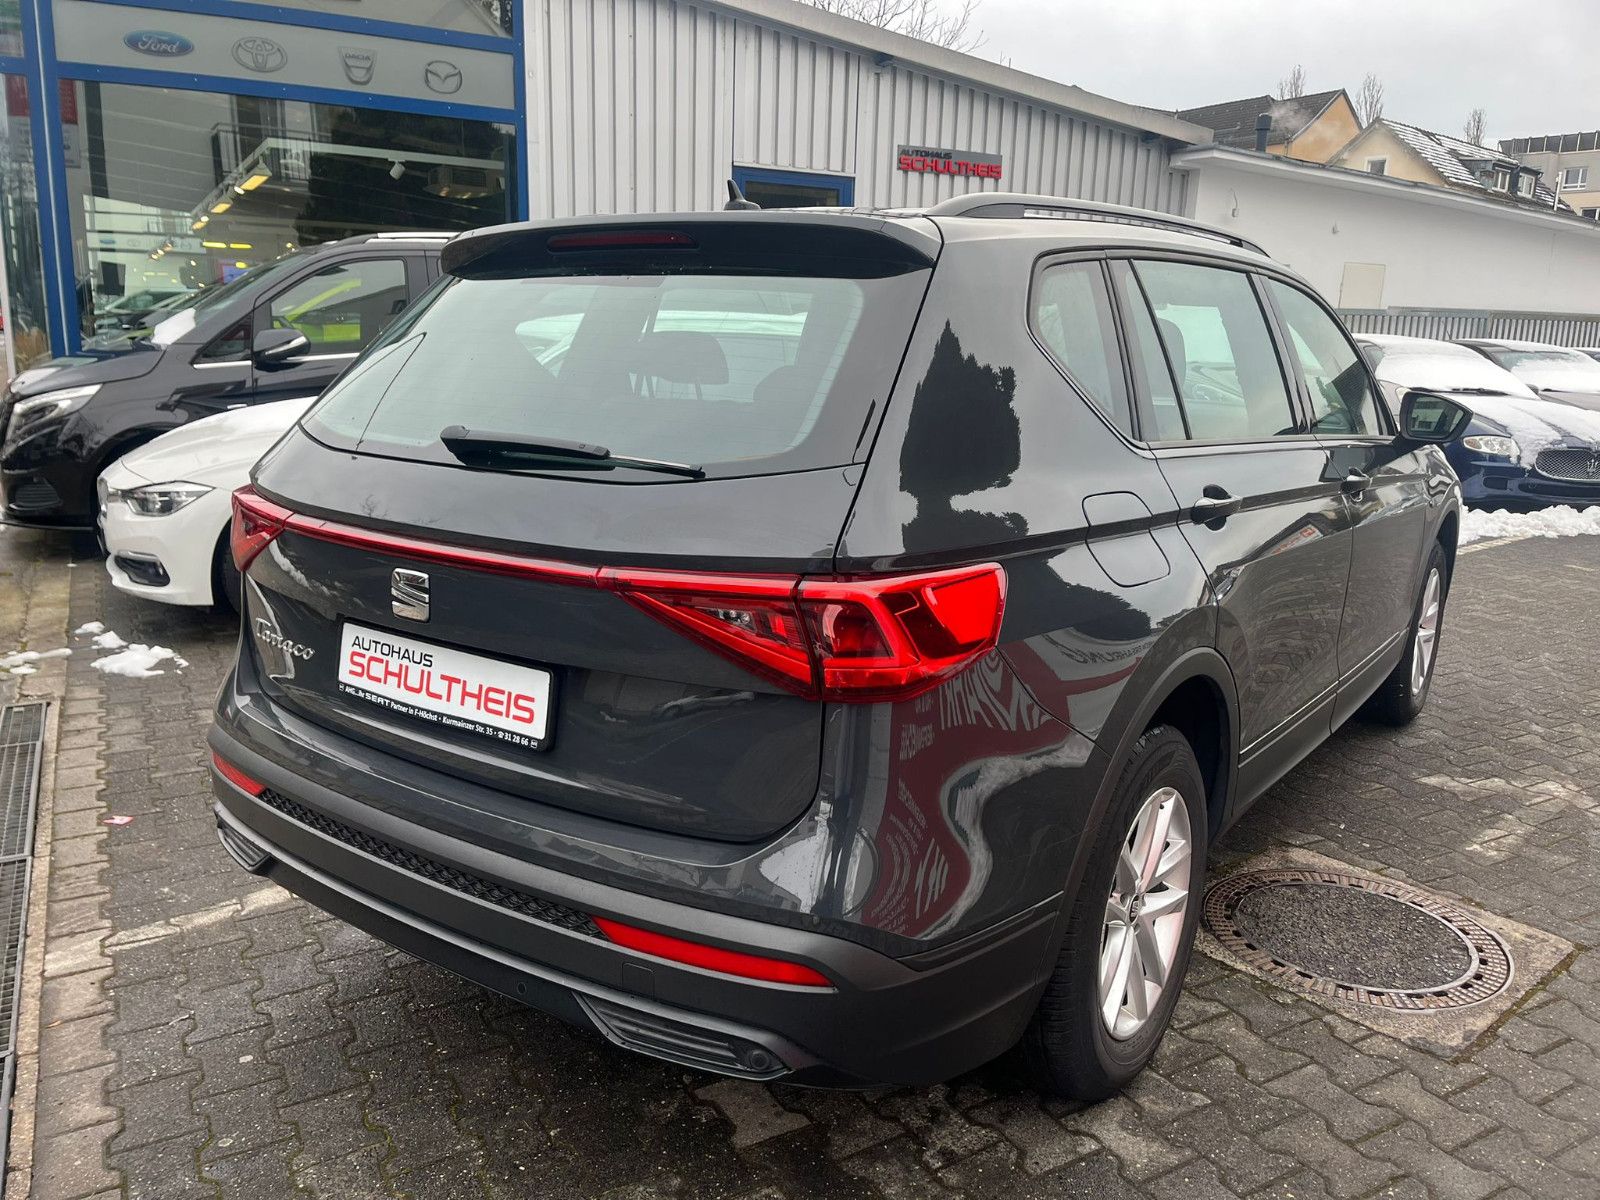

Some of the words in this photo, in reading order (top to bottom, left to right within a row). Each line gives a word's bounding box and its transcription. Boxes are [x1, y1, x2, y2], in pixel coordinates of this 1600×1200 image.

[137, 34, 180, 53] Ford
[344, 53, 372, 61] DACIA
[899, 155, 1002, 179] SCHULTHEIS
[900, 148, 953, 160] AUTOHAUS
[255, 617, 315, 660] Tarraco
[351, 635, 434, 668] AUTOHAUS
[348, 650, 535, 725] SCHULTHEIS
[365, 692, 391, 707] SEAT
[390, 701, 409, 714] Partner
[408, 706, 414, 715] in
[414, 708, 438, 722] F-Höchst
[442, 716, 475, 731] Kurmainzer
[475, 724, 485, 734] Str.
[486, 727, 494, 736] 35
[504, 732, 511, 741] 31
[512, 734, 520, 744] 28
[520, 737, 529, 747] 66
